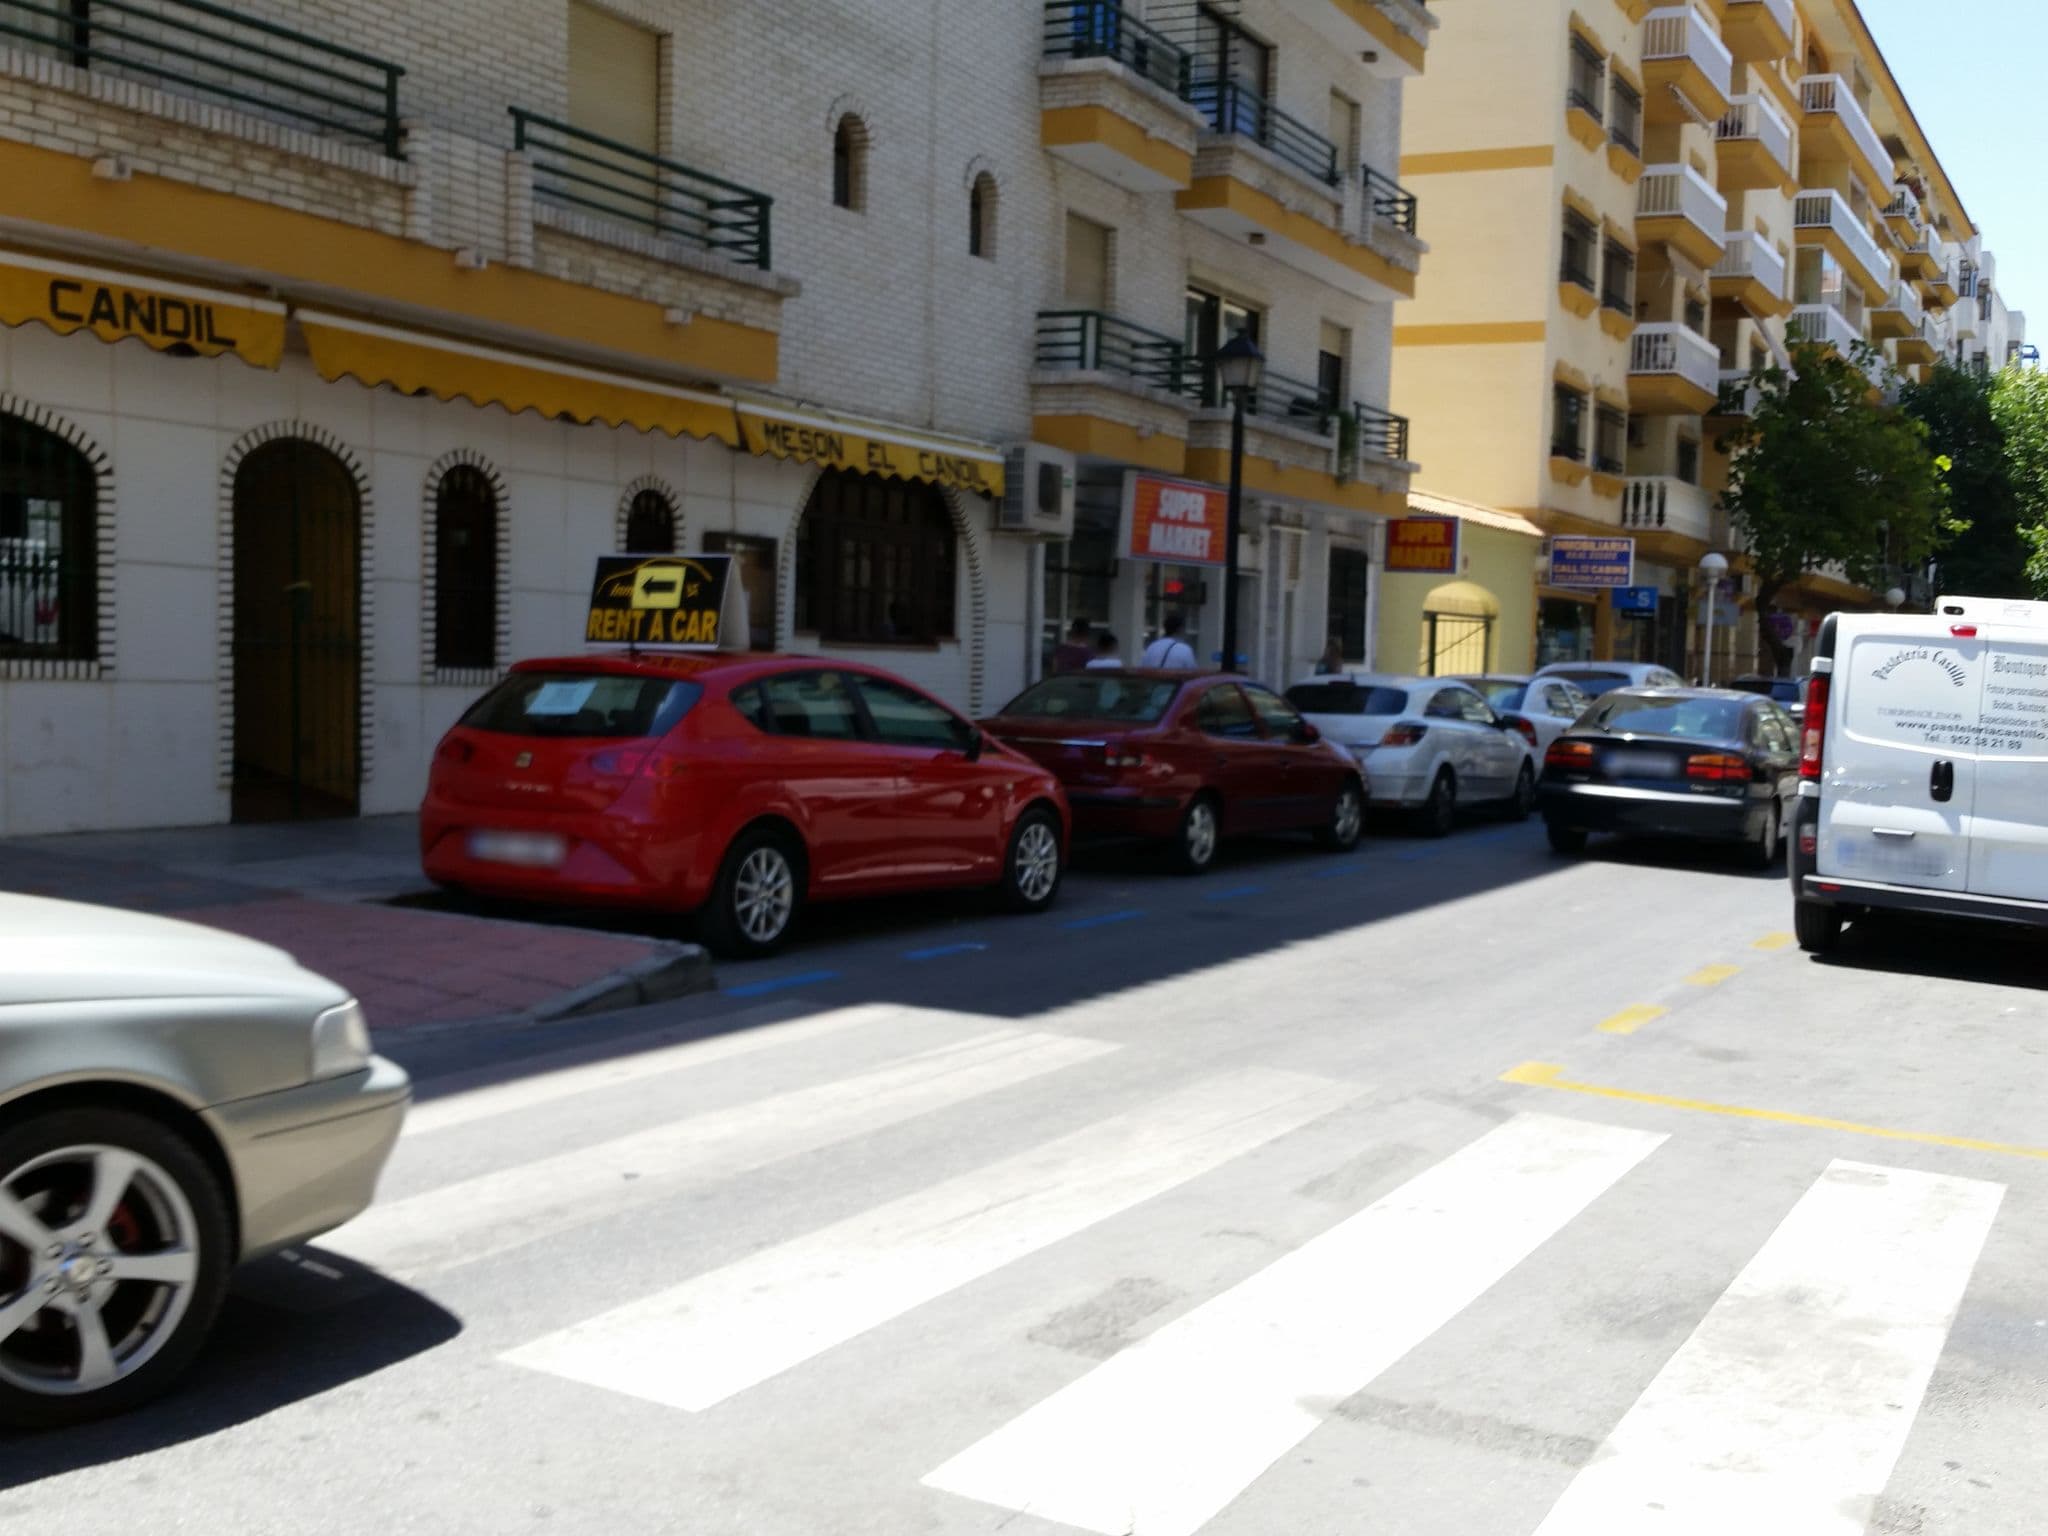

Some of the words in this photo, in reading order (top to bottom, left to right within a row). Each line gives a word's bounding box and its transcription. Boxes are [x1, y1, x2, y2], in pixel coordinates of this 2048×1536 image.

[49, 279, 237, 348] CANDIL
[764, 421, 844, 461] MESON
[866, 441, 897, 471] EL
[1157, 487, 1206, 524] SUPER
[1147, 521, 1212, 561] MARKET
[1397, 521, 1446, 545] SUPER
[1553, 540, 1630, 552] INMOBILIARIA
[1390, 545, 1452, 570] MARKET
[587, 607, 646, 641] RENT
[647, 608, 665, 642] A
[670, 608, 719, 643] CAR
[1931, 650, 1967, 688] Castillo
